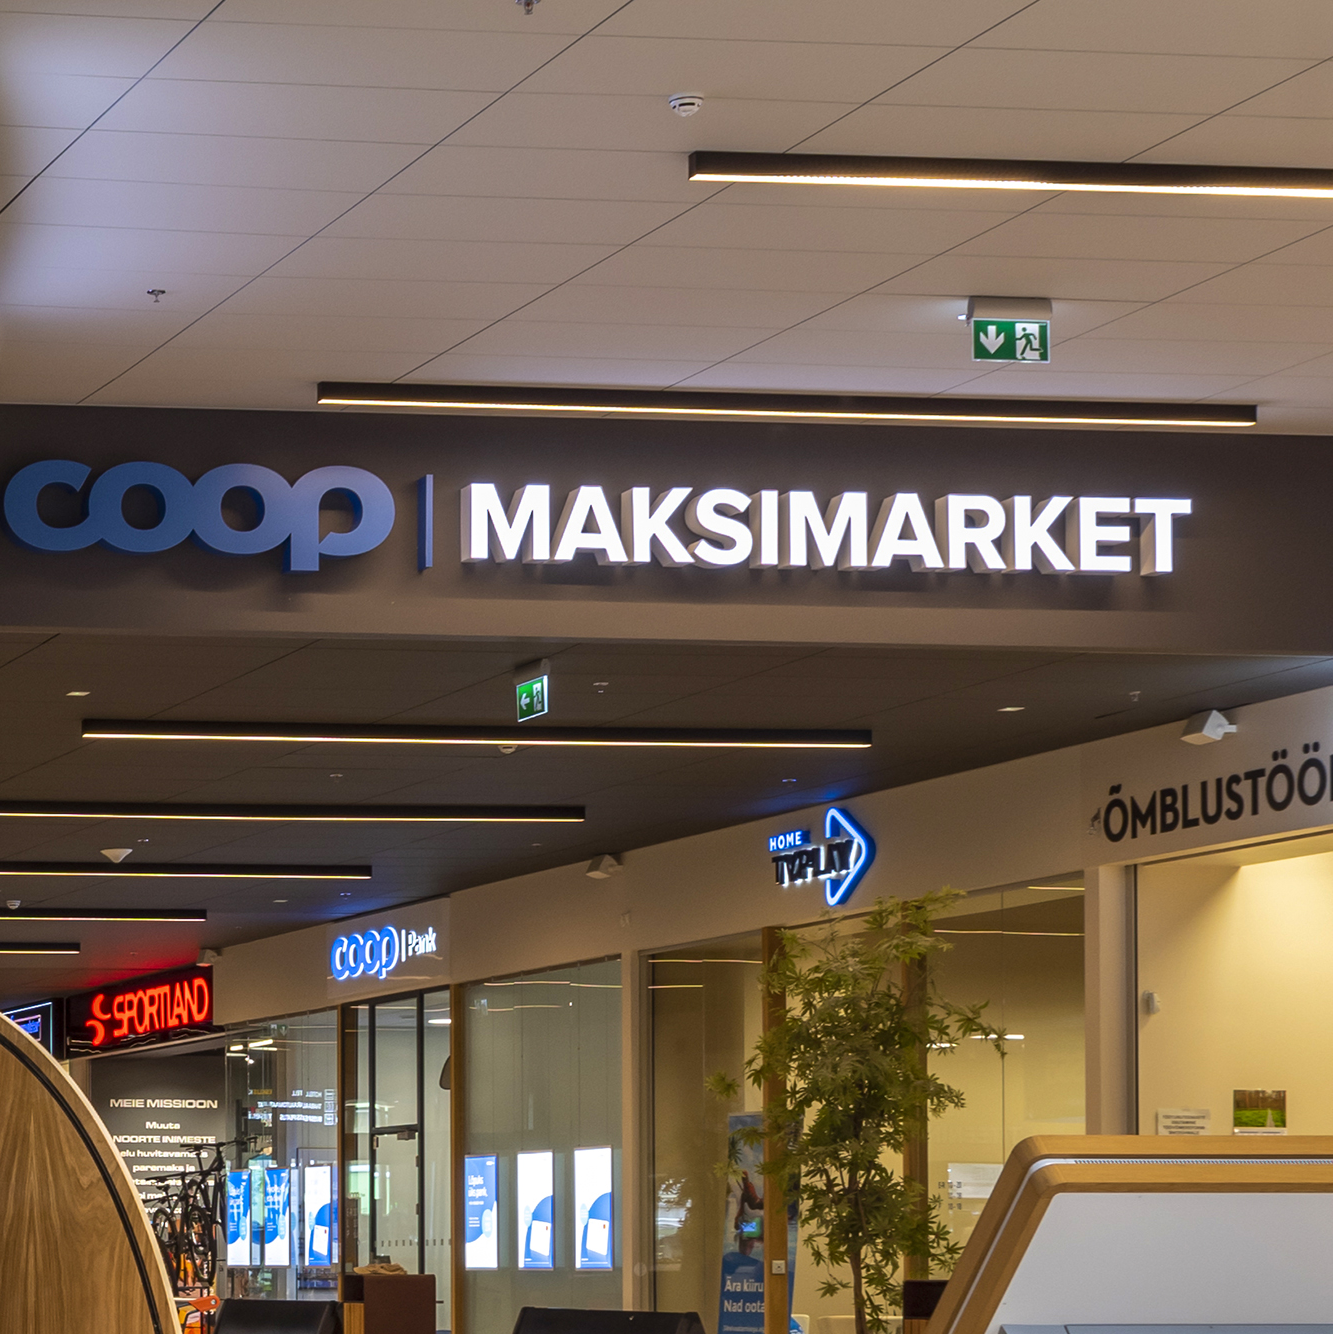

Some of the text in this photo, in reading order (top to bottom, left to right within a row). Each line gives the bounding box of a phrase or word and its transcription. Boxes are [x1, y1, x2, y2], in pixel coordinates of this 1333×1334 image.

[4, 459, 1193, 575] coop MAKSIMARKET
[1102, 741, 1333, 843] ÕMBLUSTÖÖ
[769, 831, 803, 852] HOME
[331, 924, 437, 981] coop Pank
[112, 976, 210, 1038] SPORTLAND
[109, 1098, 219, 1109] MEIE MISSIOON
[145, 1121, 181, 1130] Muuta
[113, 1135, 217, 1144] NOORTE INIMESTE
[136, 1149, 209, 1159] huvitavamas
[132, 1163, 185, 1173] paremaks
[743, 1278, 764, 1293] kiiru
[723, 1299, 765, 1313] Nad oota
